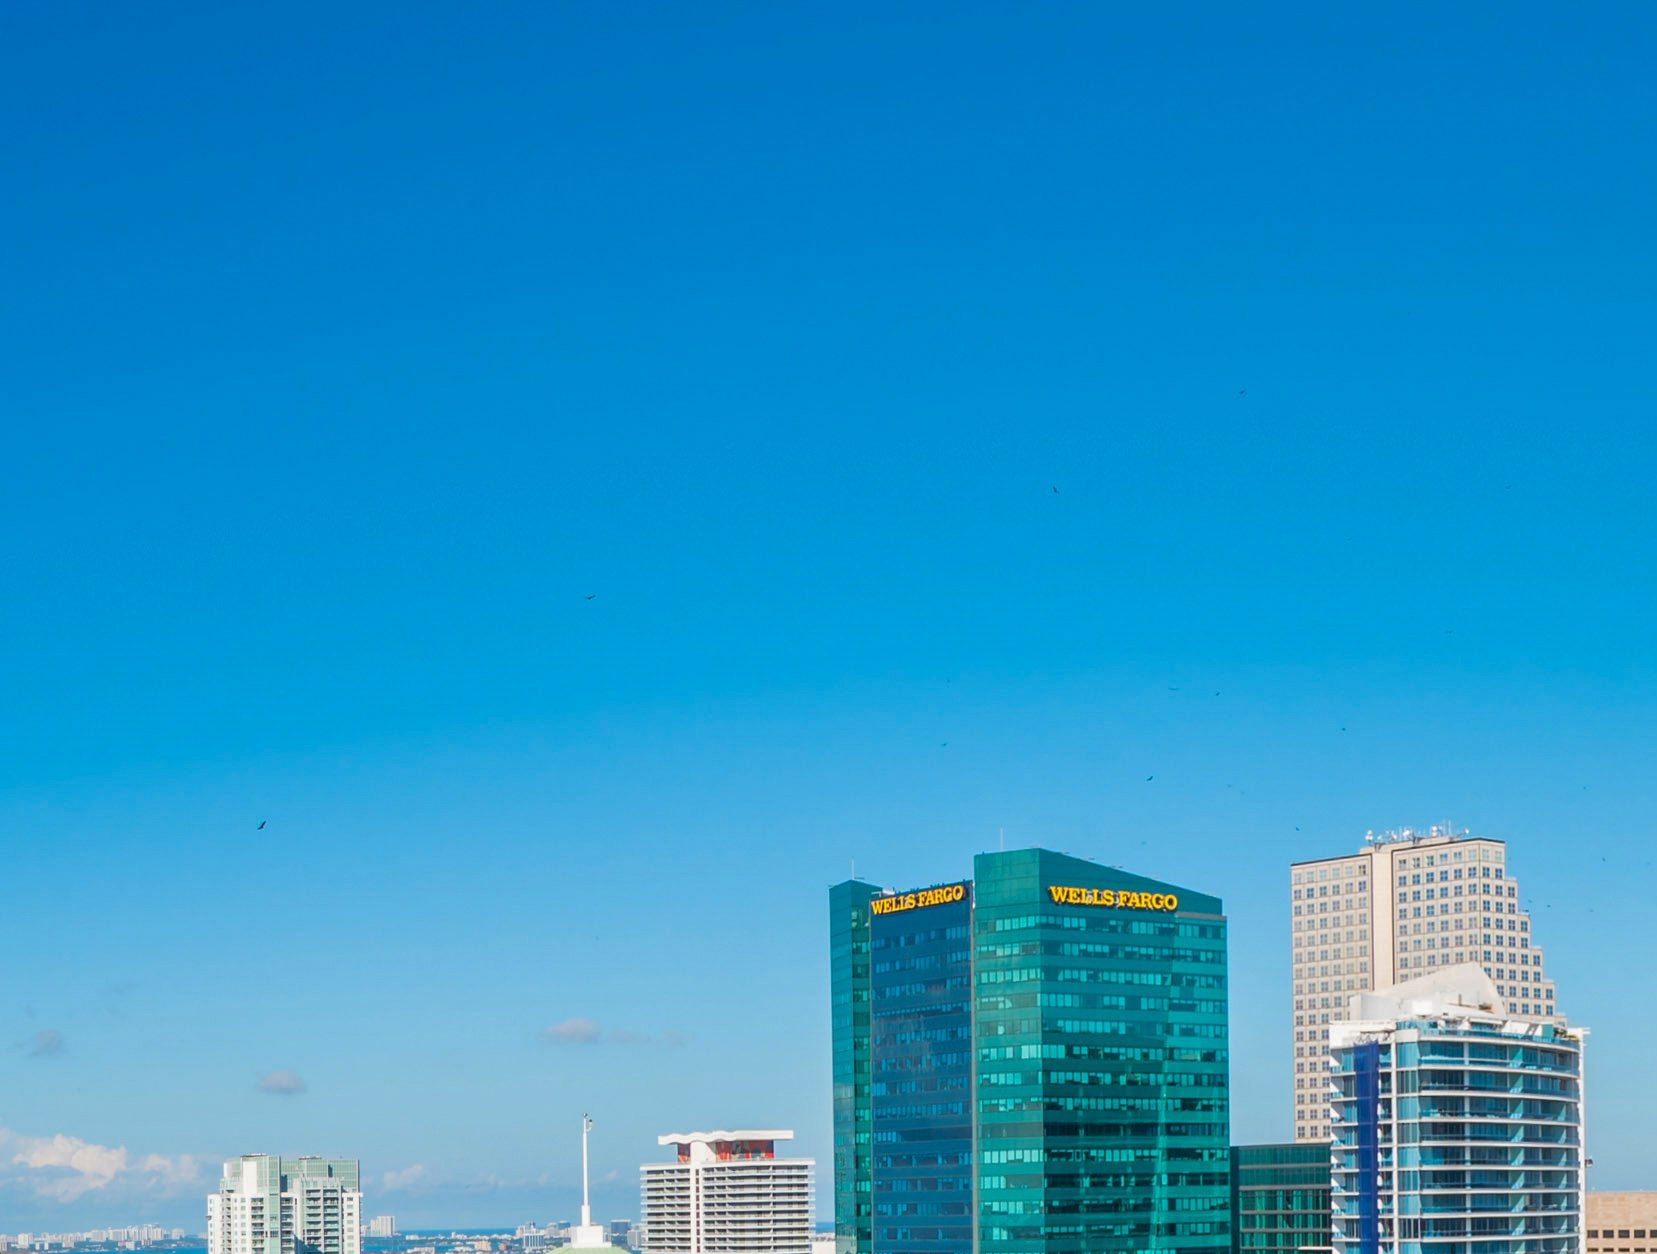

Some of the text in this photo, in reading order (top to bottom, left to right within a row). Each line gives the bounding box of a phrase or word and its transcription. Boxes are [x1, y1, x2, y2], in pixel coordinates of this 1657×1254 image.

[871, 885, 963, 915] WELLS FARGO
[1049, 886, 1178, 911] WELLS FARGO
